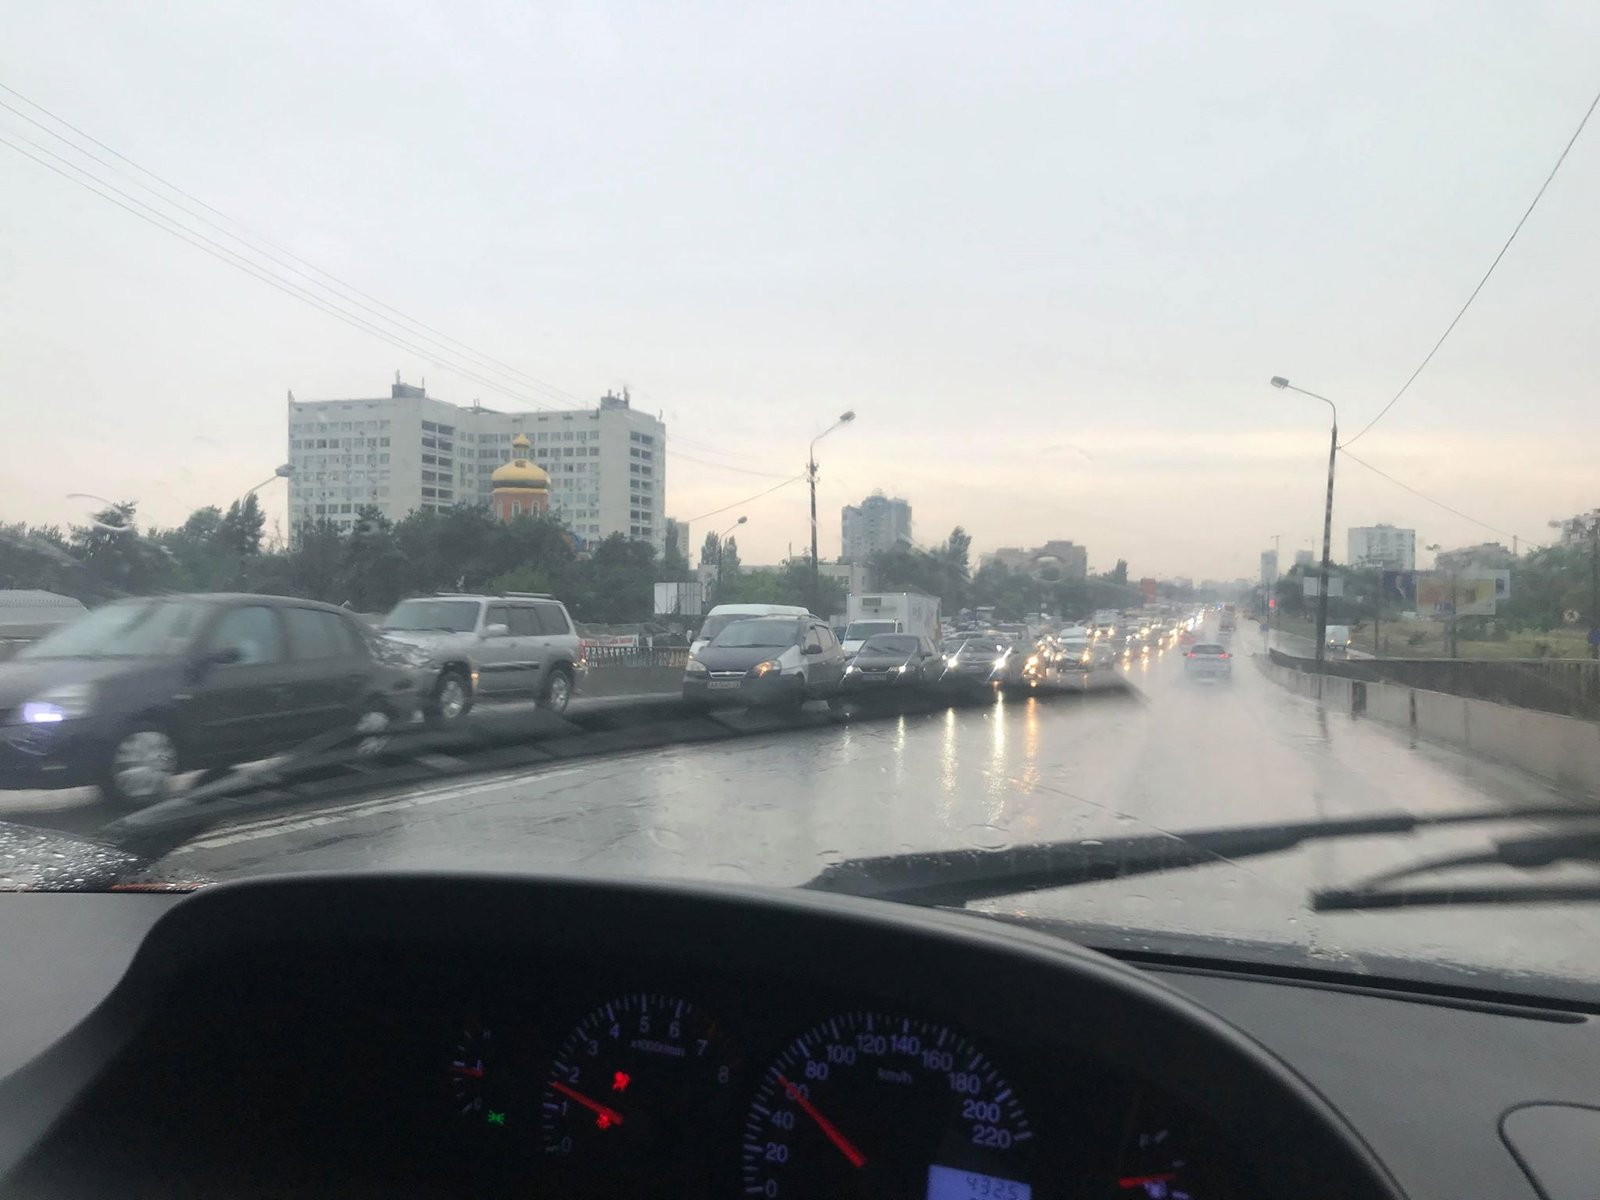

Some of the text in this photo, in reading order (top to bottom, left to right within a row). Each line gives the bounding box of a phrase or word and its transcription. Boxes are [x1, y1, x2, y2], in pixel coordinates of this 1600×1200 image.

[610, 1023, 620, 1039] 4
[640, 1014, 650, 1033] 5
[669, 1021, 680, 1038] 6
[587, 1038, 599, 1056] 3
[697, 1038, 709, 1056] 7
[856, 1034, 886, 1056] 120
[890, 1034, 921, 1056] 140
[825, 1045, 856, 1067] 100
[922, 1050, 954, 1071] 160
[568, 1067, 580, 1083] 2
[718, 1065, 729, 1084] 8
[805, 1060, 830, 1081] 80
[948, 1072, 982, 1095] 180
[561, 1100, 569, 1116] 1
[962, 1099, 1002, 1123] 200
[770, 1110, 795, 1131] 40
[561, 1136, 573, 1153] 0
[972, 1125, 1013, 1149] 220
[764, 1141, 789, 1163] 20
[764, 1178, 778, 1198] 0
